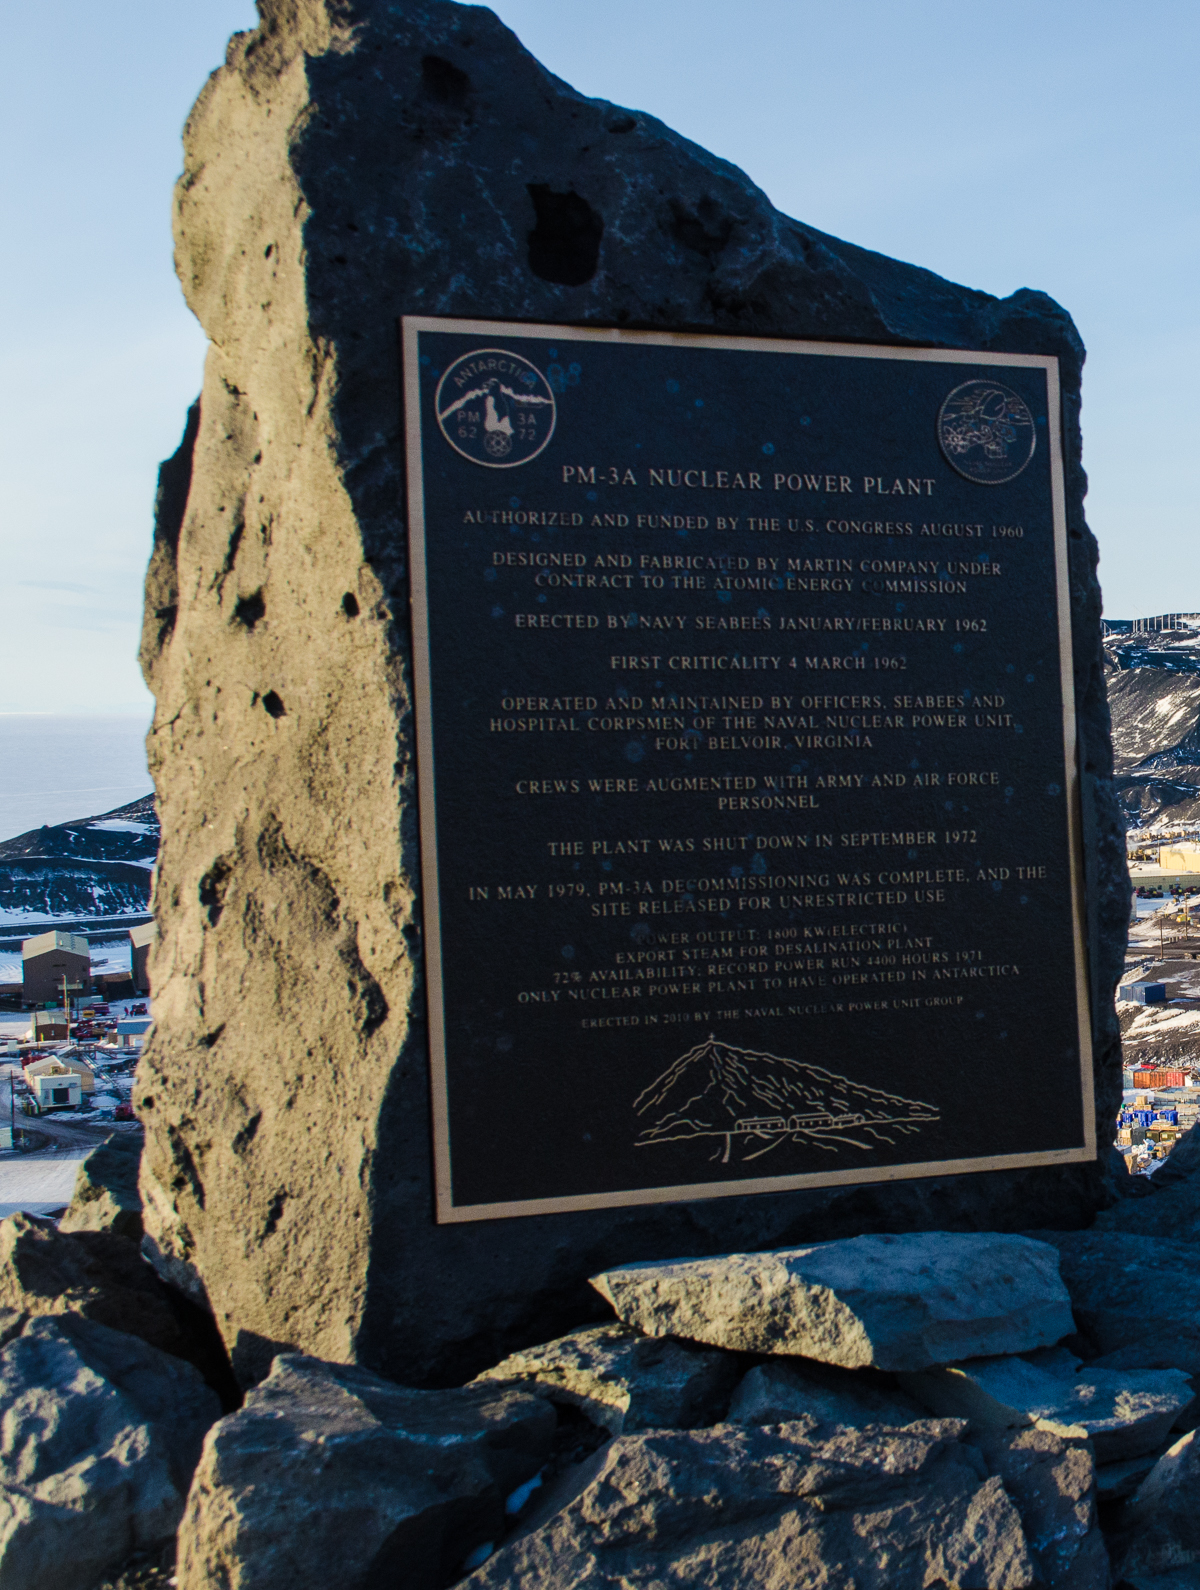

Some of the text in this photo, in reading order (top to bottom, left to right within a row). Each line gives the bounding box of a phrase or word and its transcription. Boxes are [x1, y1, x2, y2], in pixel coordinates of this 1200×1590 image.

[454, 359, 535, 388] ANTARCTICA
[457, 411, 536, 424] PM 3A
[458, 427, 535, 440] 62 72
[563, 466, 936, 496] PM-3A NUCLEAR POWER PLANT
[464, 510, 1023, 538] AUTHORIZED AND FUNDED BY THE U.S. CONGRESS AUGUST 1960
[493, 553, 1001, 575] DESIGNED AND FABRICATED BY MARTIN COMPANY UNDER
[536, 574, 966, 593] CONTRACT TO THE ATOMIC ENERGY COMMISSION
[516, 614, 987, 632] ERECTED BY NAVY SEABEES JANUARY/FEBRUARY 1962
[611, 656, 907, 670] FIRST CRITICALITY 4 MARCH 1962
[502, 698, 596, 710] OPERATED
[606, 698, 642, 710] AND
[652, 697, 762, 709] MAINTAINED
[772, 696, 793, 708] BY
[894, 696, 964, 708] SEABEES
[972, 696, 1004, 708] AND
[490, 718, 579, 731] HOSPITAL
[588, 718, 684, 730] CORPSMEN
[693, 717, 715, 729] OF
[725, 716, 756, 729] THE
[764, 716, 818, 728] NAVAL
[826, 715, 904, 728] NUCLEAR
[912, 715, 966, 727] POWER
[656, 738, 700, 750] FORT
[794, 736, 872, 748] VIRGINIA
[516, 772, 999, 793] CREWS WERE AUGMENTED WITH ARMY AND AIR FORCE
[718, 796, 819, 810] PERSONNEL
[548, 831, 977, 856] THE PLANT WAS SHUT DOWN IN SEPTEMBER 1972
[469, 887, 488, 900] IN
[498, 886, 537, 899] MAY
[600, 882, 653, 895] PM-3A
[662, 874, 830, 892] DECOMMISSIONING
[838, 873, 870, 886] WAS
[976, 868, 1010, 880] AND
[1016, 866, 1046, 878] THE
[592, 890, 945, 916] SITE RELEASED FOR UNRESTRICTED USE
[638, 934, 690, 945] POWER
[768, 928, 797, 939] 1800
[616, 938, 932, 963] EXPORT STEAM FOR DESALINATION PLANT
[554, 972, 582, 984] 72%
[708, 962, 768, 975] RECORD
[776, 960, 824, 972] POWER
[832, 958, 860, 968] RUN
[902, 952, 948, 964] HOURS
[956, 951, 982, 962] 1971
[518, 966, 1019, 1004] ONLY NUCLEAR POWER PLANT TO HAVE OPERATED IN ANTARCTICA
[582, 1016, 639, 1029] ERECTED
[646, 1016, 658, 1025] IN
[694, 1012, 710, 1021] BY
[718, 1010, 739, 1020] THE
[745, 1006, 783, 1018] NAVAL
[788, 1004, 843, 1016] NUCLEAR
[849, 1000, 888, 1012] POWER
[894, 998, 920, 1008] UNIT
[926, 996, 962, 1007] GROUP
